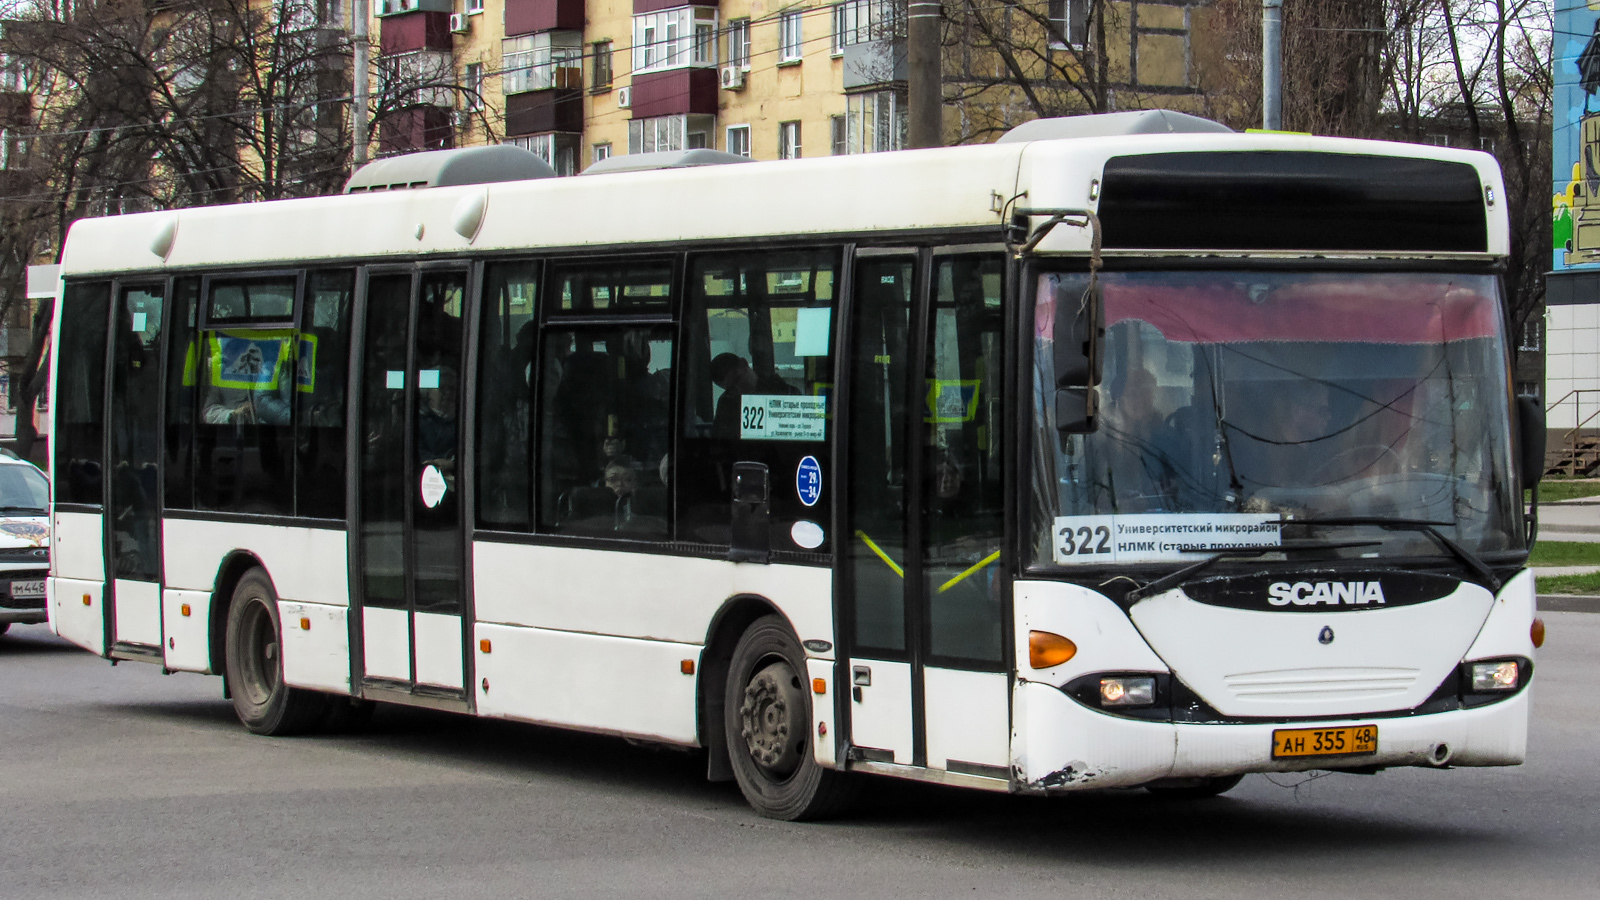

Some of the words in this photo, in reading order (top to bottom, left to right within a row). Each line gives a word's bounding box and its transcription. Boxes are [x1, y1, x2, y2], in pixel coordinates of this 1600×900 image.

[743, 406, 764, 430] 322
[808, 471, 817, 484] 29
[808, 486, 817, 498] 34
[1117, 523, 1213, 536] Университетский
[1215, 523, 1278, 535] микрорайон
[1059, 525, 1111, 556] 322
[1118, 541, 1156, 552] НЛМК
[1268, 581, 1386, 606] SCANIA
[1313, 730, 1345, 751] 355
[1355, 728, 1371, 744] 48
